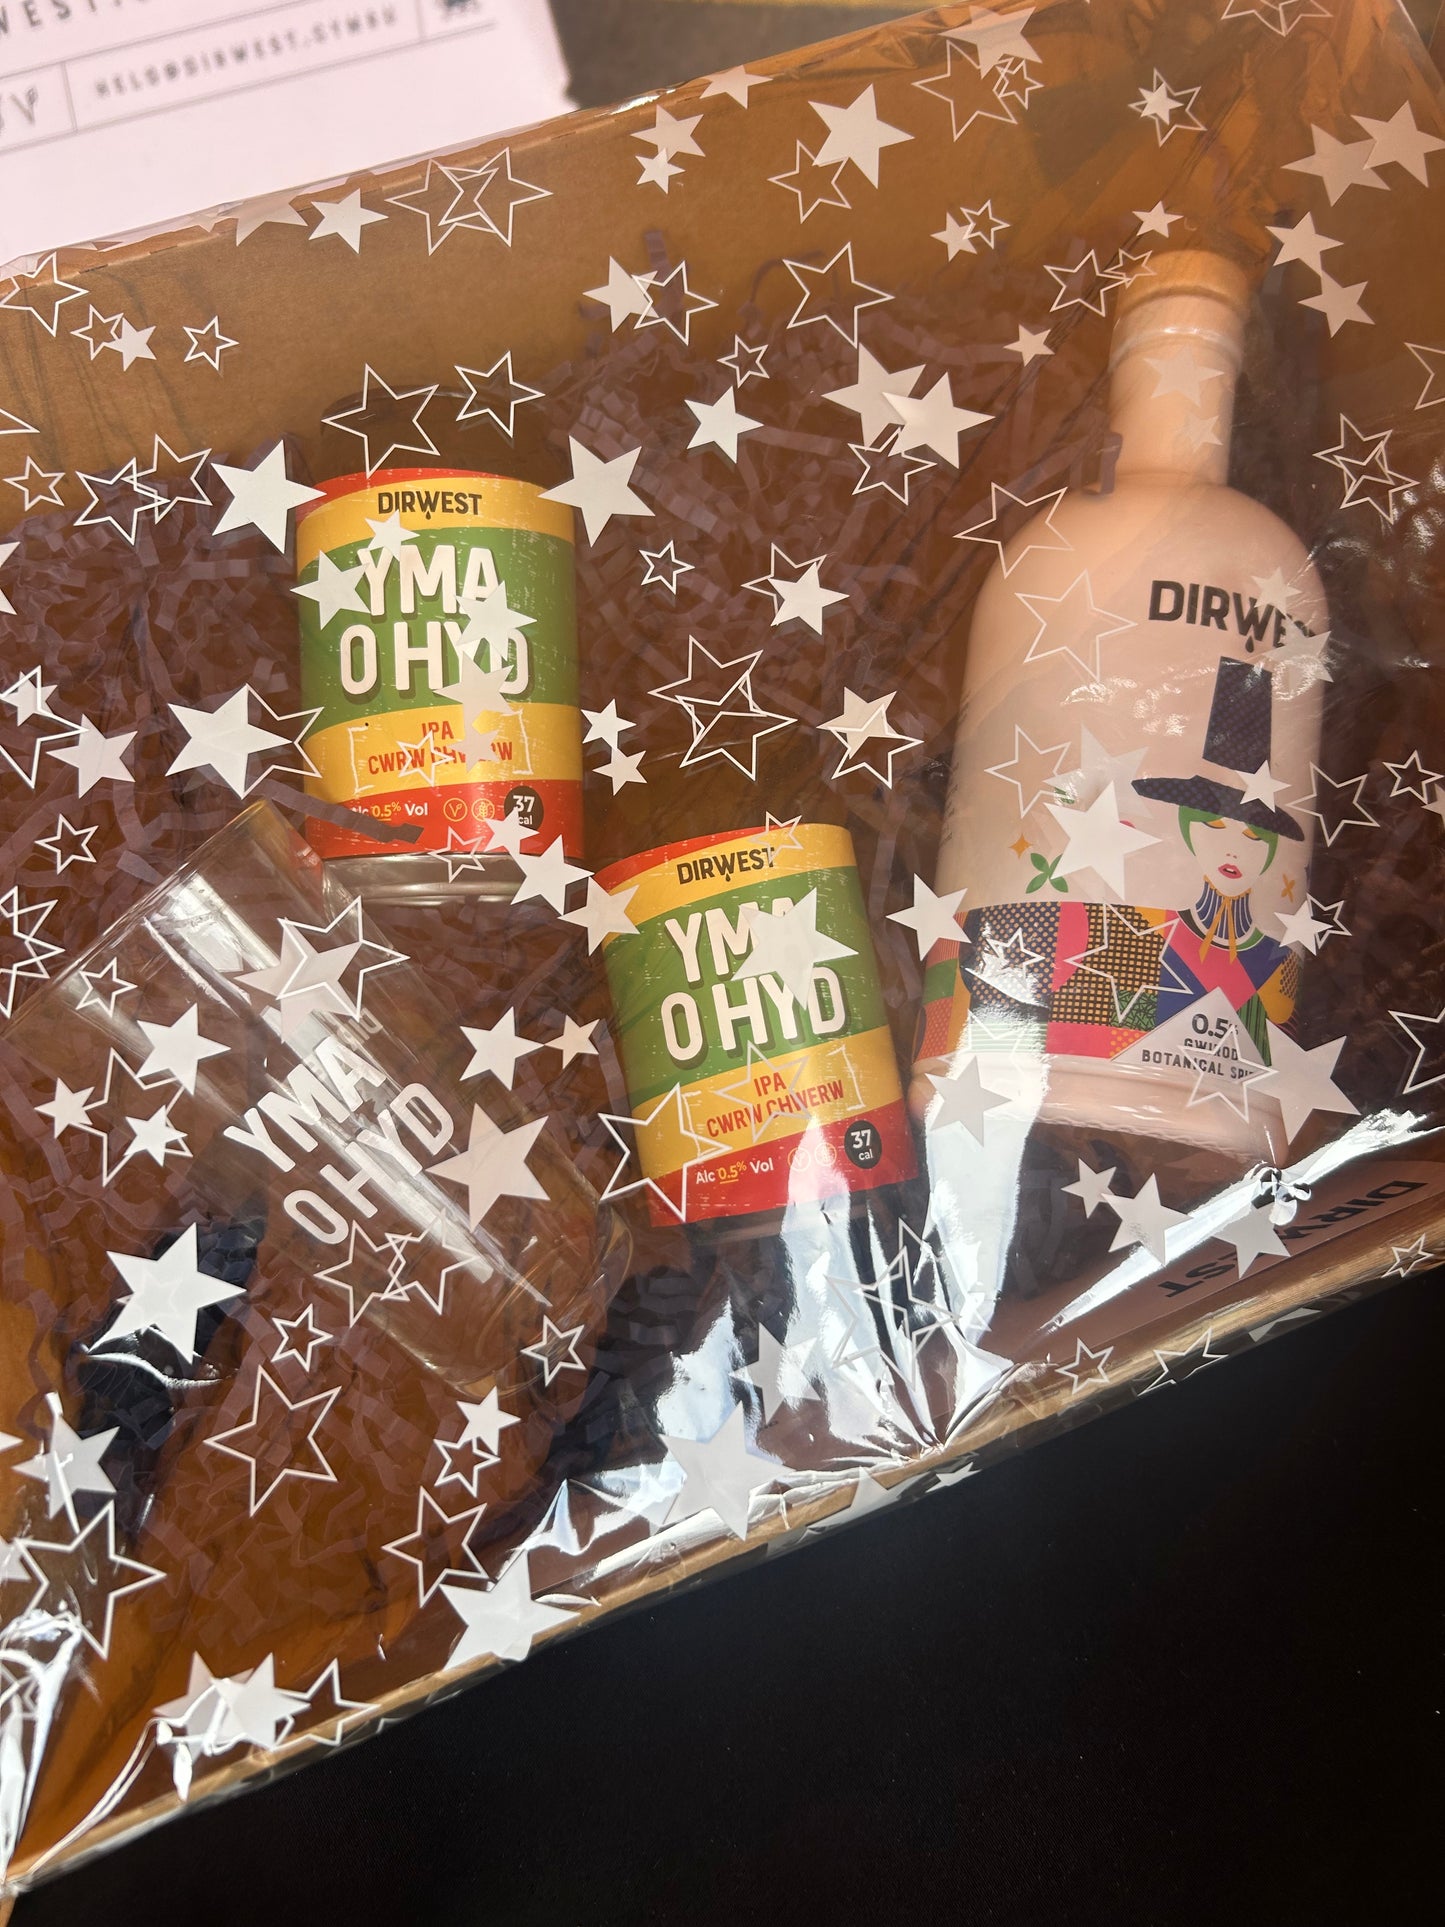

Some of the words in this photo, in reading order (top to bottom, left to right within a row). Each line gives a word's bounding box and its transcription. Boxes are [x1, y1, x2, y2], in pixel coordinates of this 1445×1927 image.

[378, 491, 482, 516] DIRWEST
[357, 544, 502, 616] YMA
[421, 720, 454, 742] IPA
[368, 748, 425, 775] CWRW
[404, 802, 428, 816] Vol
[512, 794, 535, 813] 37
[676, 846, 776, 886] DIRWEST
[664, 896, 797, 983] YM
[1141, 1049, 1225, 1077] BOTANICAL
[753, 1071, 787, 1097] IPA
[223, 1034, 388, 1173] YMA
[706, 1103, 763, 1138] CWRW
[766, 1079, 845, 1119] CHWERW
[850, 1128, 872, 1149] 37
[858, 1149, 874, 1162] cal
[695, 1170, 716, 1185] Alc
[750, 1157, 775, 1174] Vol
